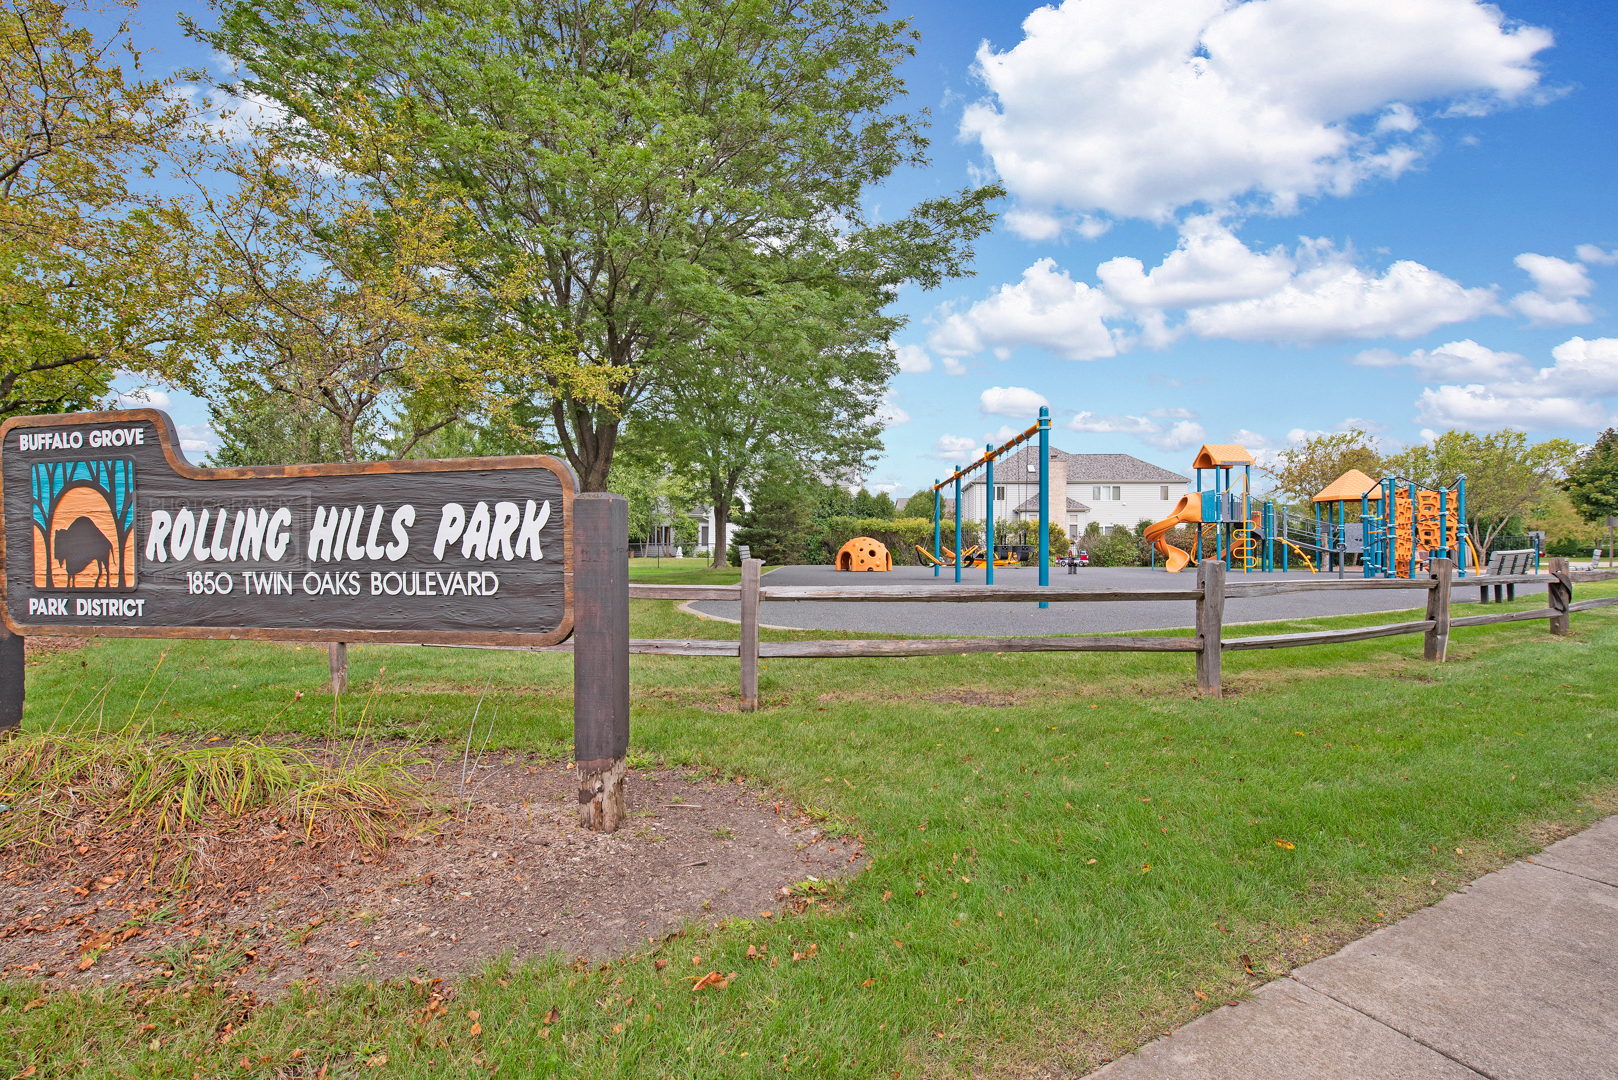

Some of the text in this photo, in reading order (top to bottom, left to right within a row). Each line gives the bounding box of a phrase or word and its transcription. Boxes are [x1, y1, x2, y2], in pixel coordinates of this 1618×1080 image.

[19, 428, 144, 451] BUFFALO GROVE
[145, 499, 550, 562] ROLLING HILLS PARK
[186, 571, 233, 595] 1850
[241, 571, 293, 595] TWIN
[302, 571, 360, 595] OAKS
[370, 571, 499, 595] BOULEVARD
[28, 598, 145, 616] PARK DISTRICT
